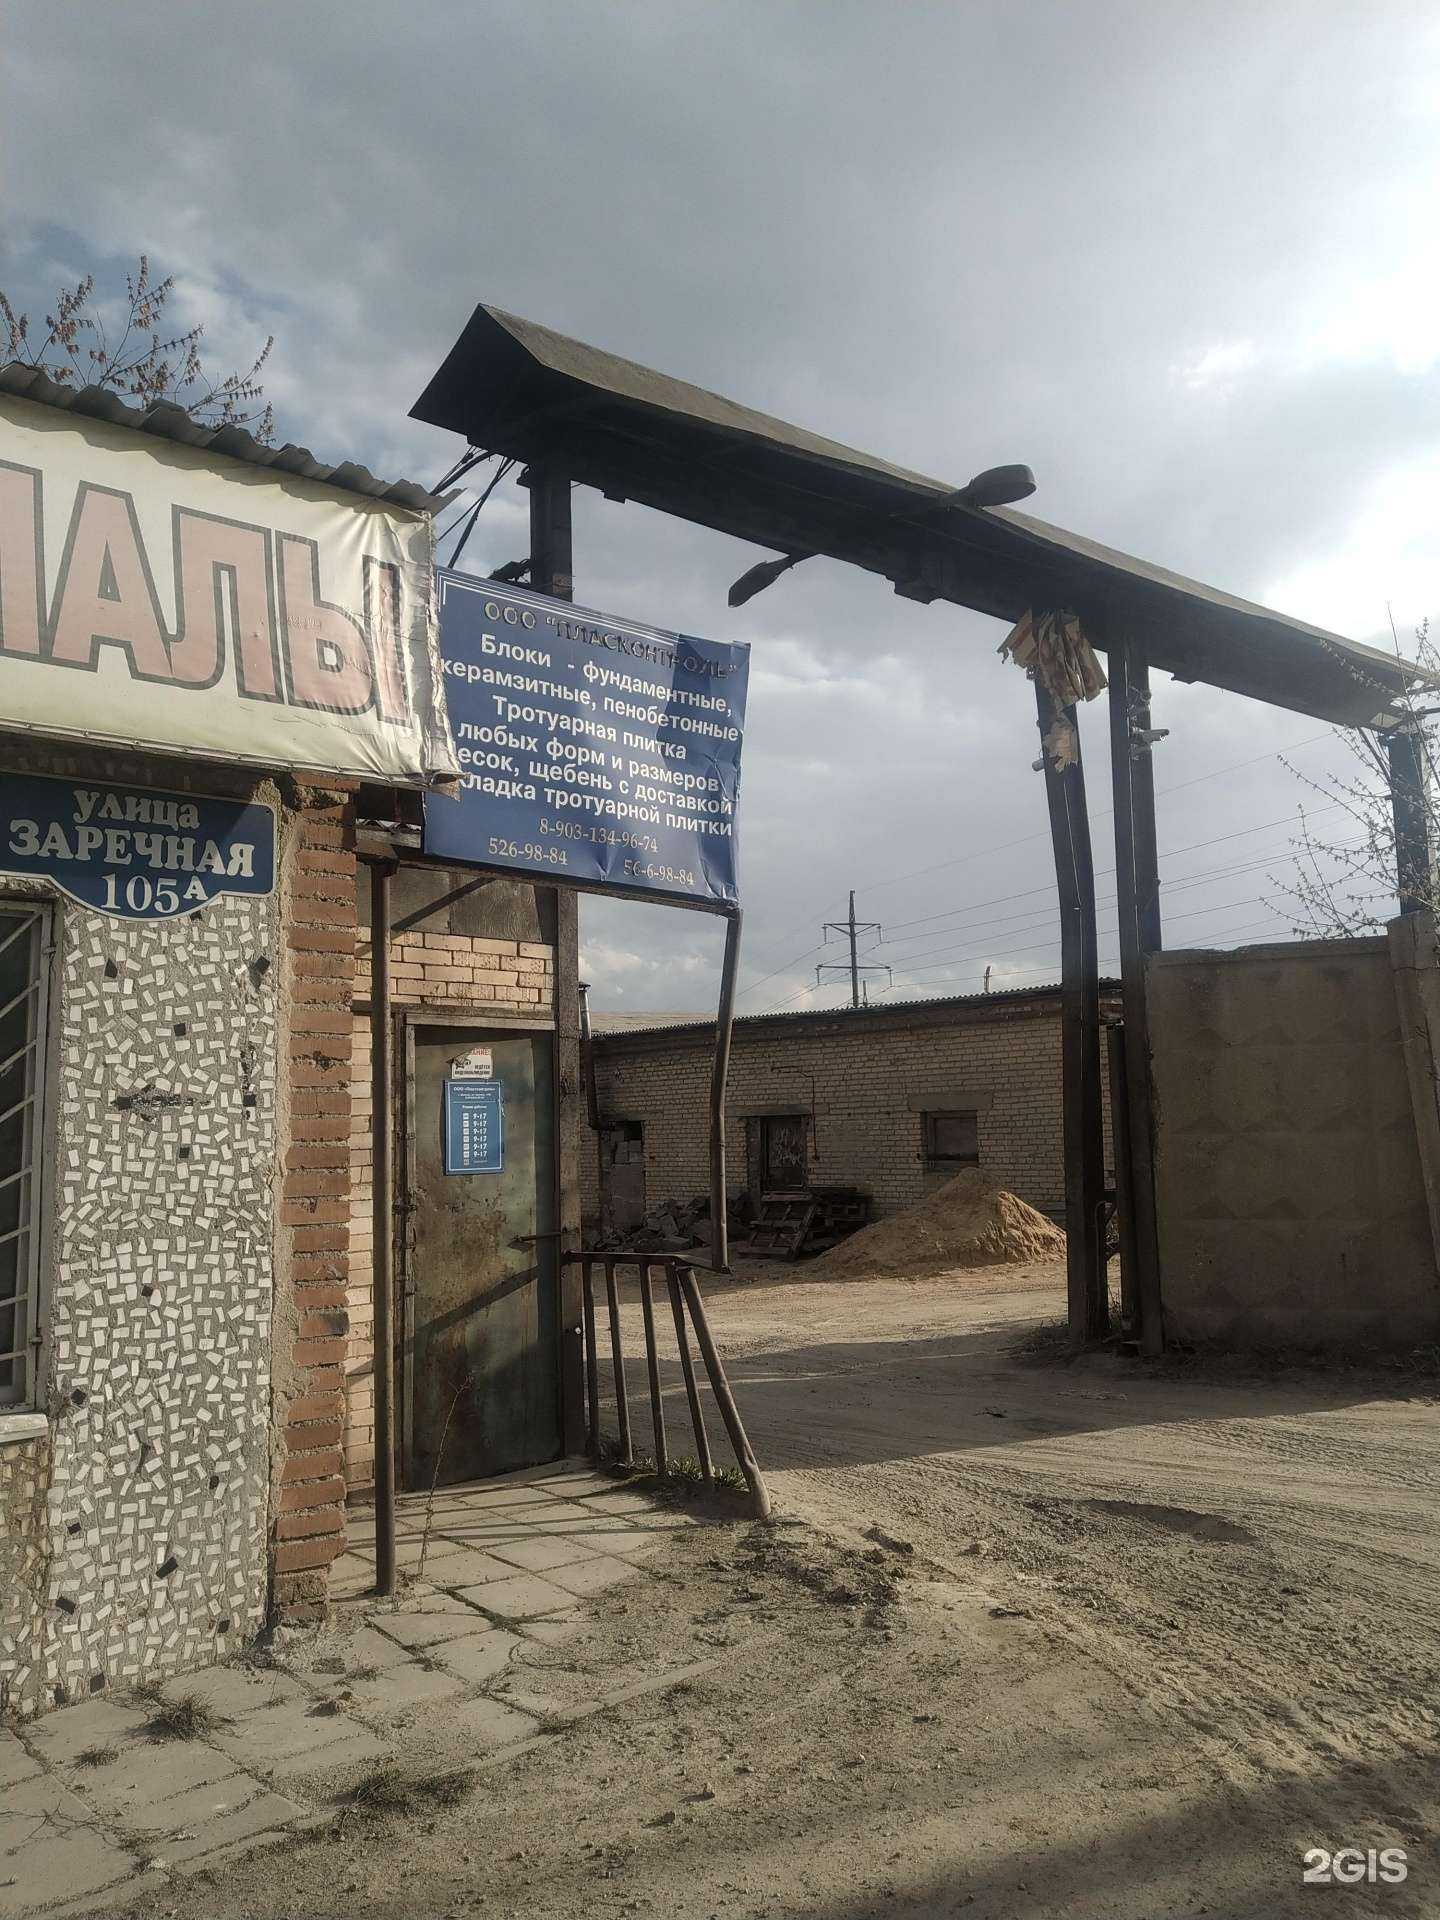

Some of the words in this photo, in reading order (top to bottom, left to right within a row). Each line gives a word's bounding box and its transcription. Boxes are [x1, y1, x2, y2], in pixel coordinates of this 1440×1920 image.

[484, 601, 536, 630] ООО
[441, 658, 597, 711] керамзитные,
[603, 696, 739, 742] пенобетонные
[481, 633, 551, 668] Блоки
[582, 660, 732, 717] фундаментные,
[457, 722, 538, 752] любых
[546, 736, 605, 766] форм
[611, 755, 622, 770] и
[629, 760, 719, 792] размеров
[492, 694, 617, 742] Тротуарная
[623, 731, 687, 760] плитка
[457, 746, 520, 777] есок,
[529, 761, 613, 791] щебень
[619, 779, 629, 794] с
[634, 783, 732, 815] доставкой
[539, 817, 659, 853] 8-903-134-96-74
[543, 787, 660, 824] тротуарной
[666, 813, 732, 837] плитки
[8, 819, 255, 878] ЗАРЕЧНАЯ
[488, 836, 569, 866] 526-98-84
